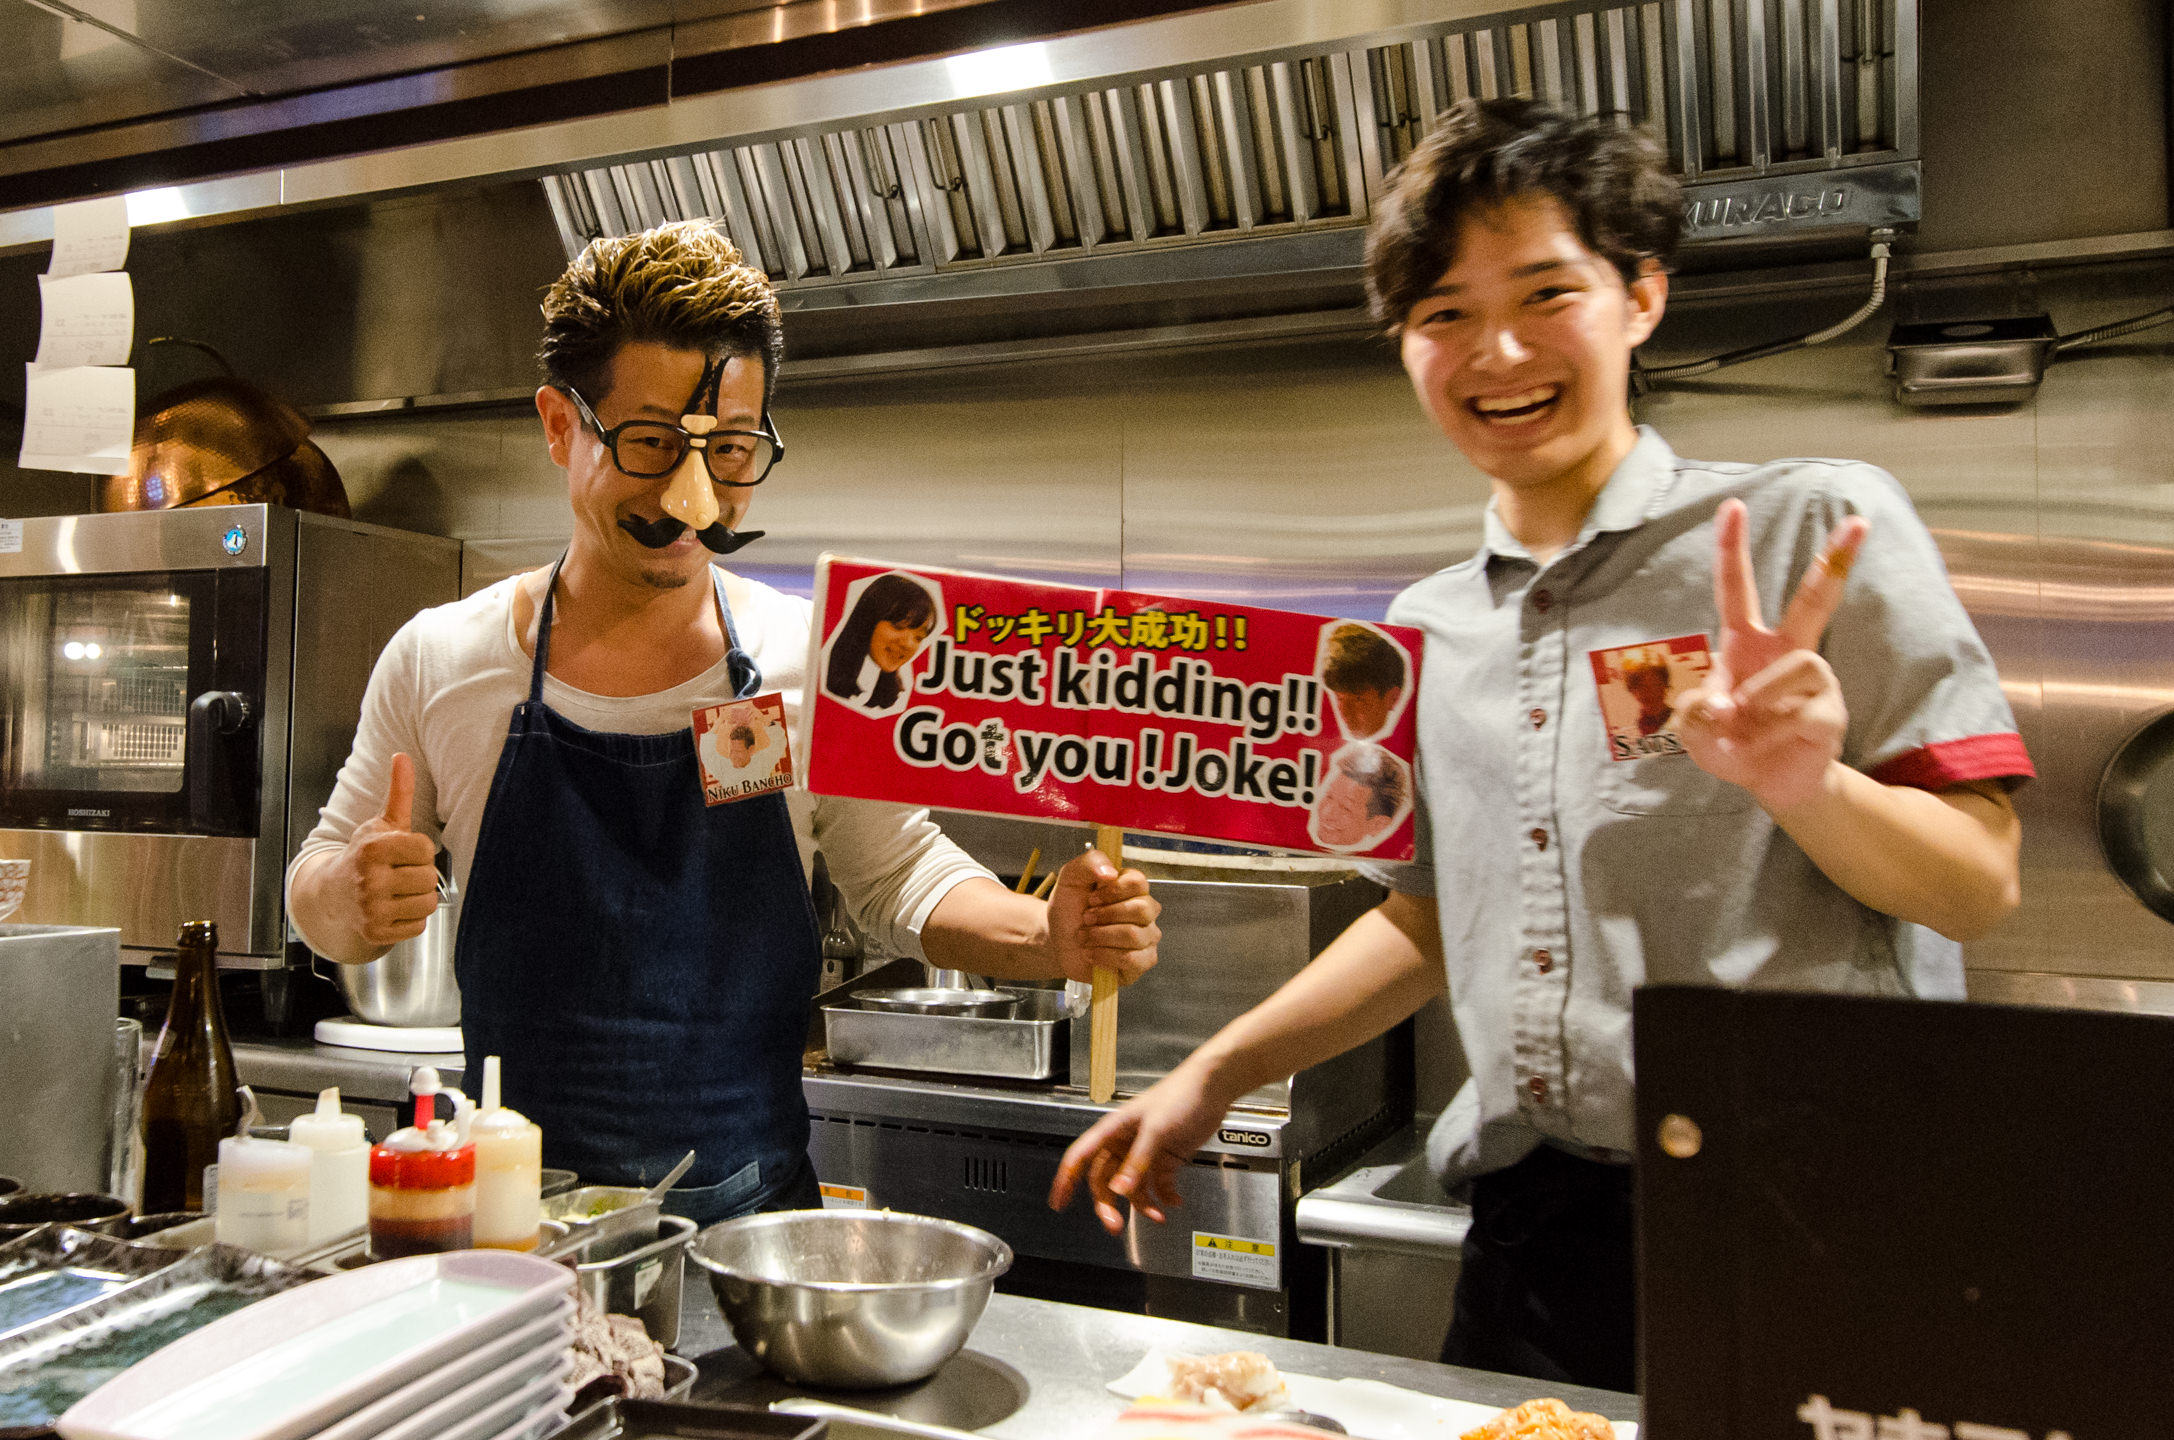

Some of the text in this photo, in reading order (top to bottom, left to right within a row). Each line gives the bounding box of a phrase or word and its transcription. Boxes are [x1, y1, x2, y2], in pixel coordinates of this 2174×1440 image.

[921, 640, 1318, 739] Just kidding!!
[900, 711, 1004, 770] Got
[1222, 1130, 1268, 1145] tanico
